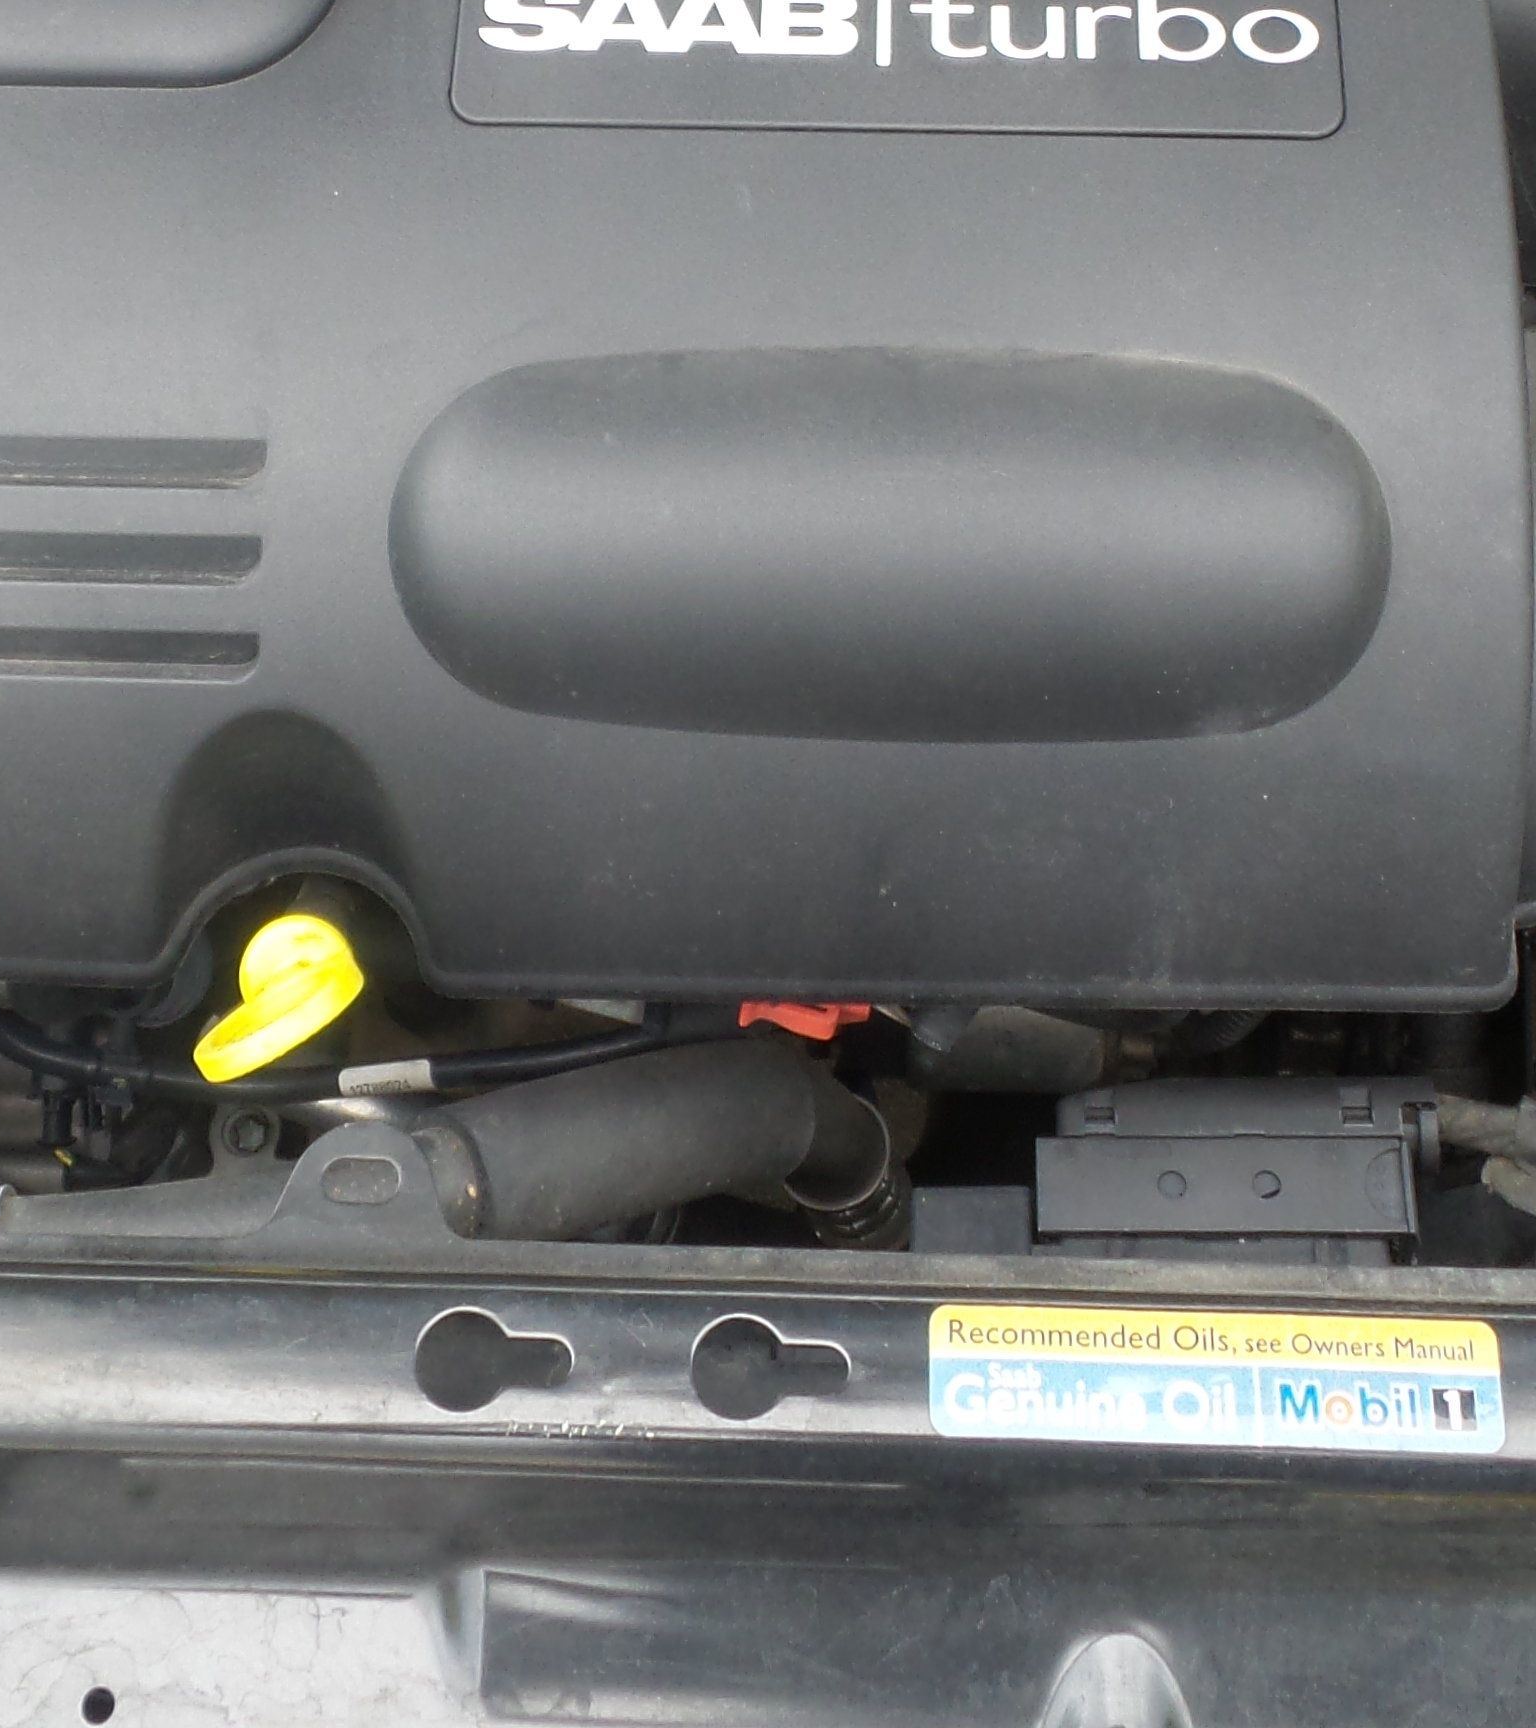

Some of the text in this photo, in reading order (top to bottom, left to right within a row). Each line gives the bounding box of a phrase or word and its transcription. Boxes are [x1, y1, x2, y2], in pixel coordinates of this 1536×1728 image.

[947, 1319, 1475, 1363] Recommended Oils, see Owners Manual
[943, 1372, 1237, 1433] Genuine Oil
[1278, 1382, 1418, 1430] Mobil
